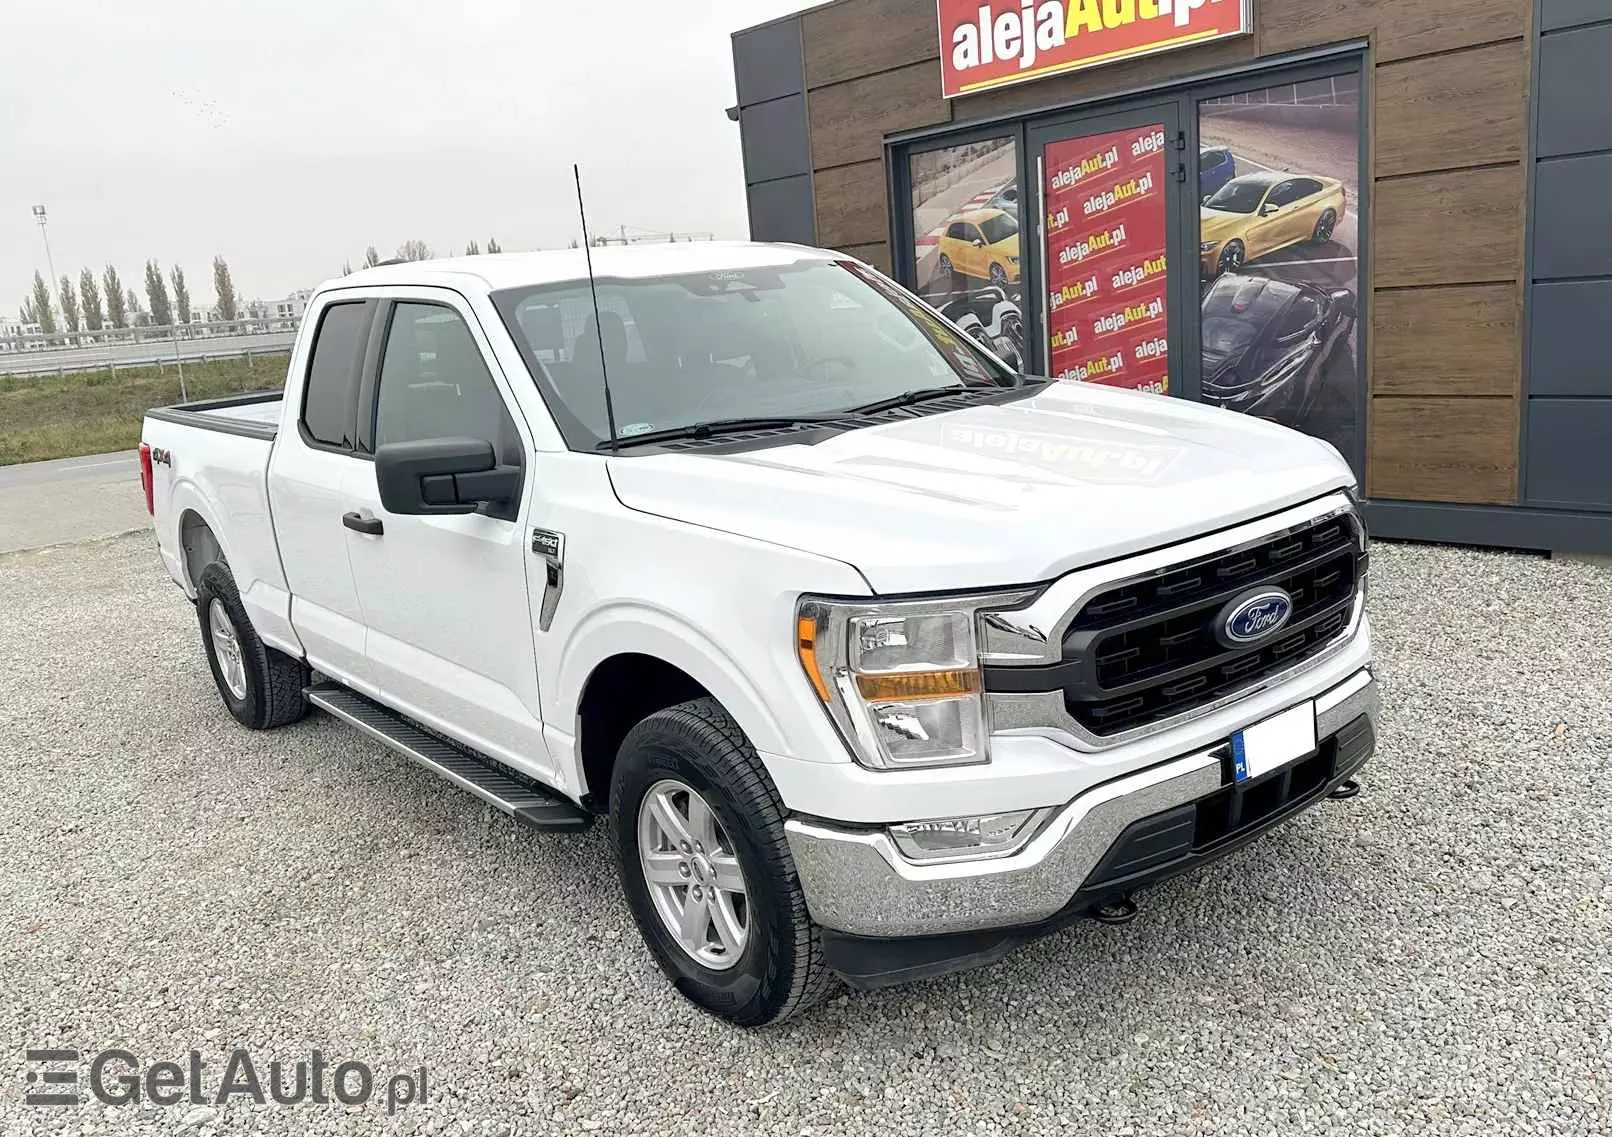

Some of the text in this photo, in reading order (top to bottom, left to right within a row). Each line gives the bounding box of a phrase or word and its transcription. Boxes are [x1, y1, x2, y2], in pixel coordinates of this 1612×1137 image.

[1051, 146, 1119, 190] alejaAut.pl
[1083, 172, 1152, 214] alejaAut.pl
[1059, 224, 1126, 264] alejaAut.pl
[1093, 297, 1163, 334] alejaAut.pl
[1244, 602, 1279, 634] Ford
